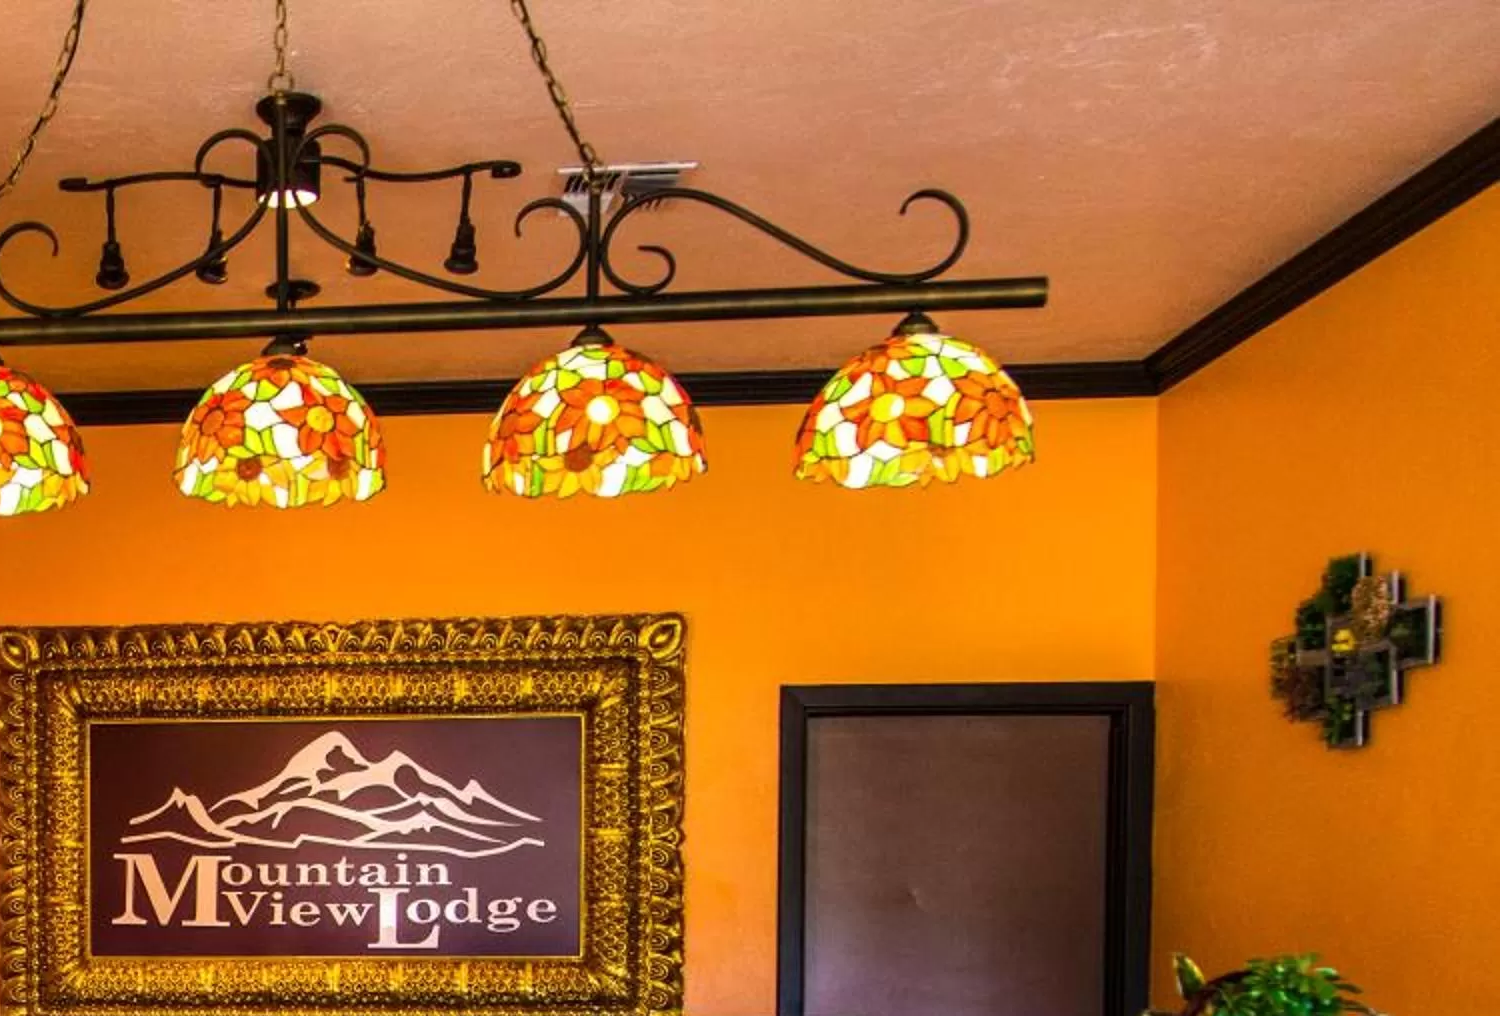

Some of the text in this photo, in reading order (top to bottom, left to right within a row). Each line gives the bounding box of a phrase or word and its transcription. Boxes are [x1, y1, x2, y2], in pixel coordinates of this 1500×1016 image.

[111, 854, 453, 927] Mountain
[221, 887, 557, 949] View Lodge
